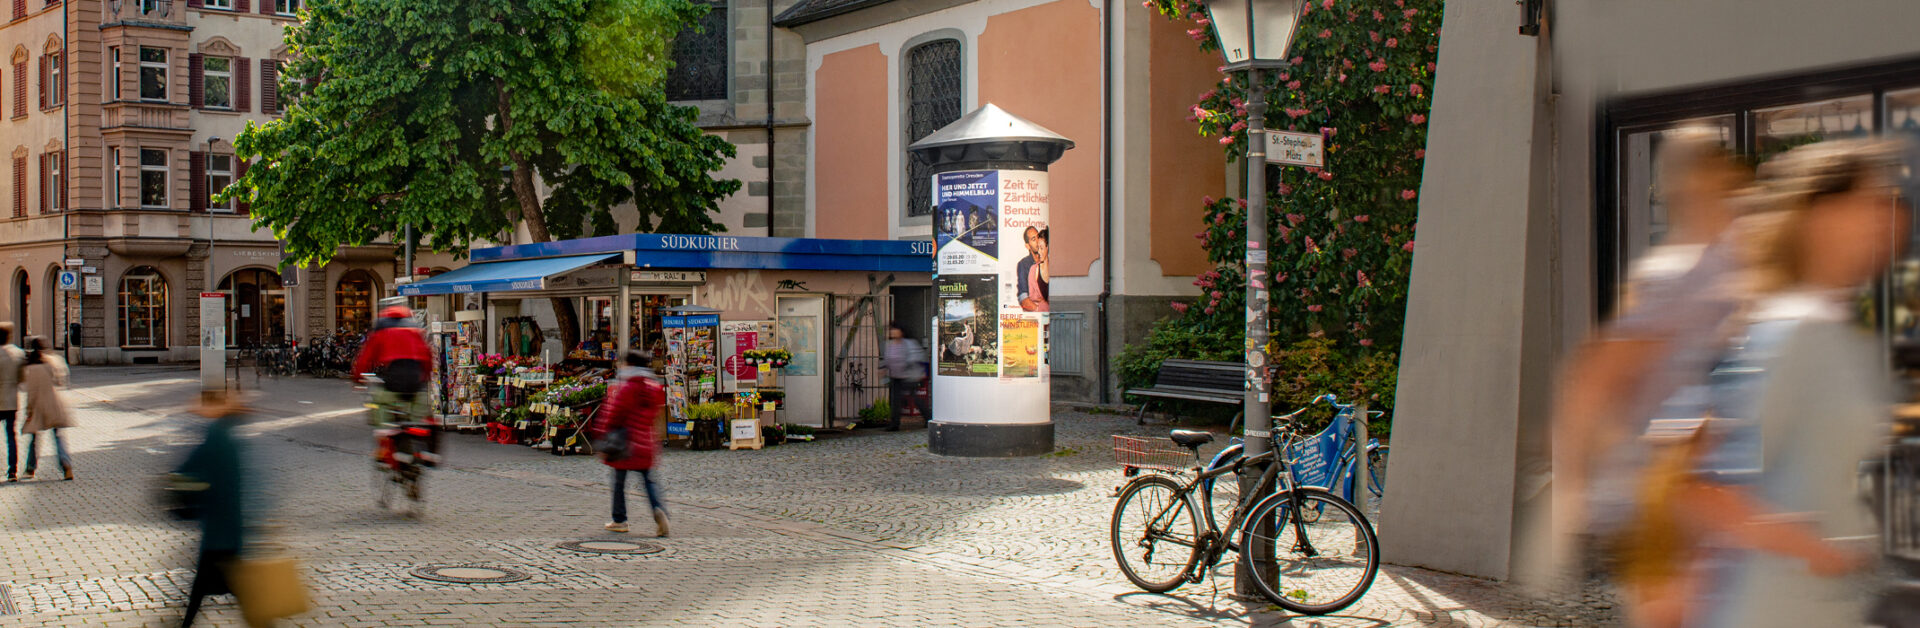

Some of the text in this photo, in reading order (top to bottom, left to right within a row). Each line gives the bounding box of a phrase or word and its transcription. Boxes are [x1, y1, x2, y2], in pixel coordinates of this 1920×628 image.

[1233, 48, 1243, 59] 11
[1285, 149, 1302, 161] Platz
[967, 182, 988, 190] JETZT
[1004, 179, 1039, 190] Zeit für
[1004, 205, 1041, 216] Benutzt
[661, 234, 739, 250] SÜDKURIER
[911, 240, 933, 255] SÜD
